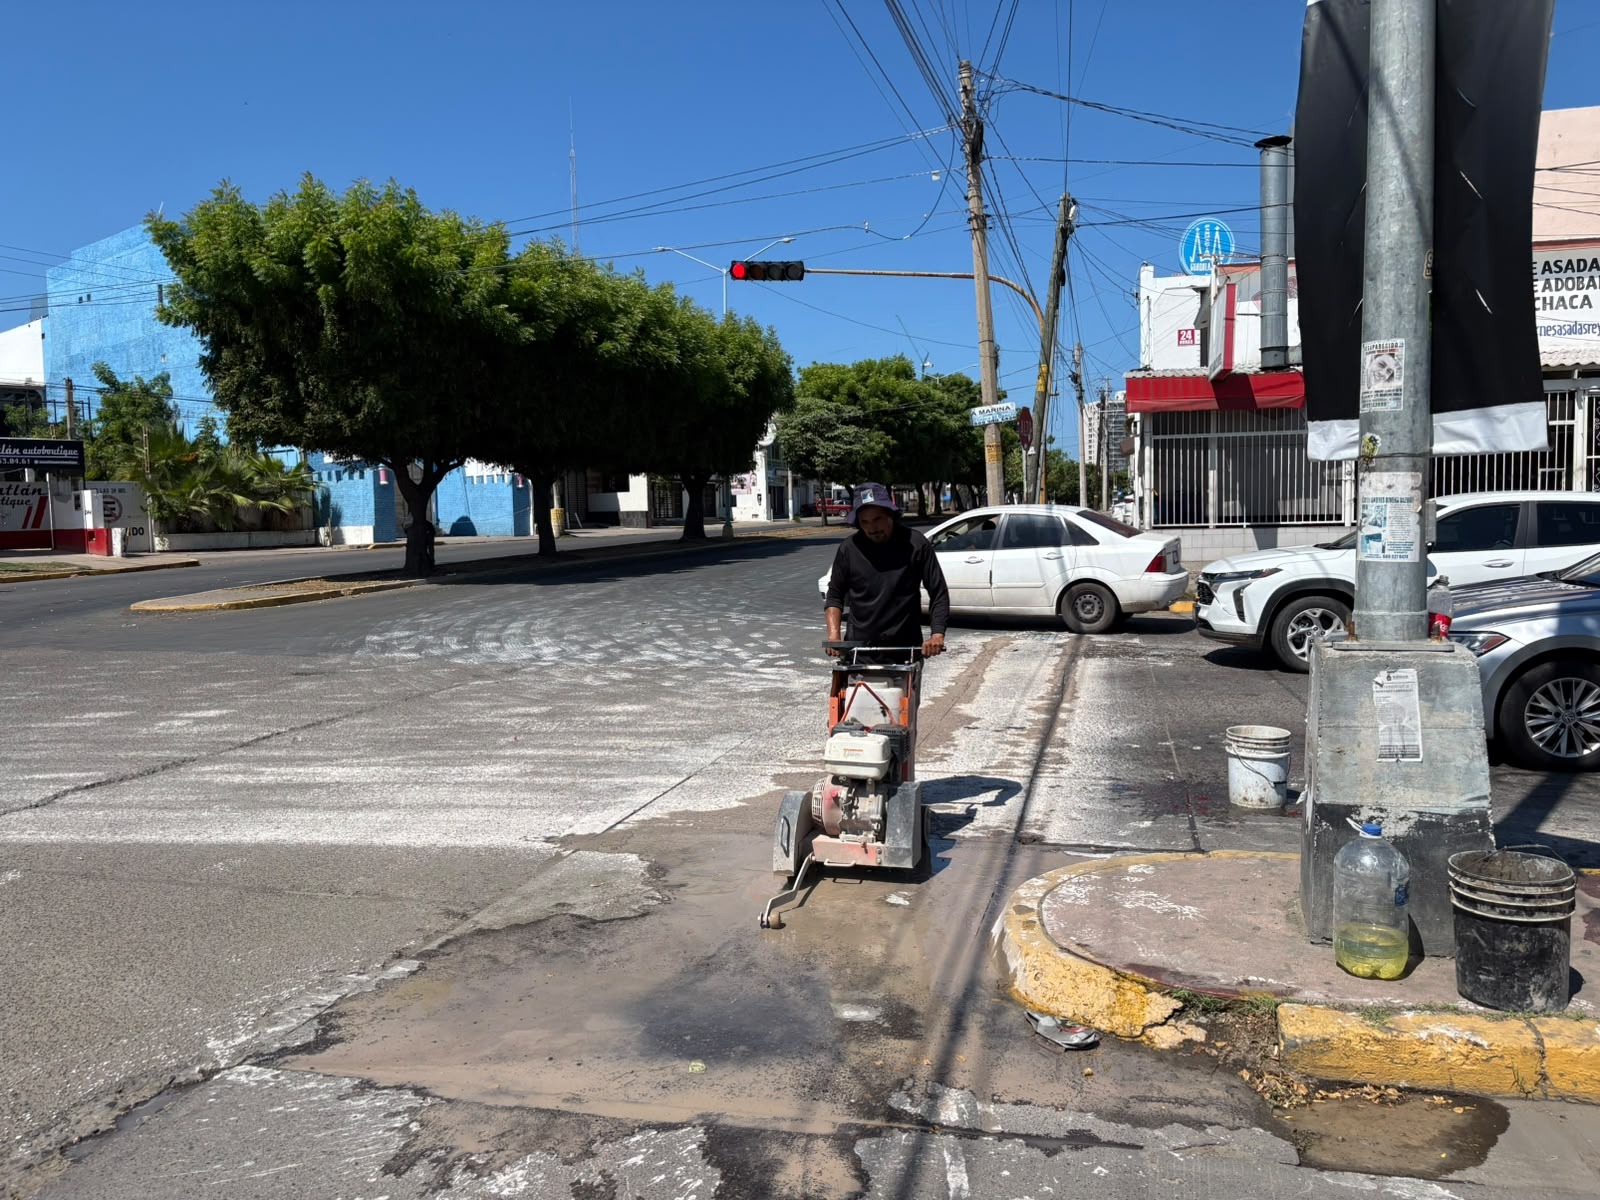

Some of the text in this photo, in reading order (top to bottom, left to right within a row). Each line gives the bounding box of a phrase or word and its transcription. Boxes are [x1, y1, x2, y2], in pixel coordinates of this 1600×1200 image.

[1541, 257, 1600, 275] ASADA
[1542, 275, 1600, 292] ADOBA
[1179, 331, 1192, 341] 24
[979, 405, 1010, 415] MARINA
[0, 443, 79, 456] lán autoboutique
